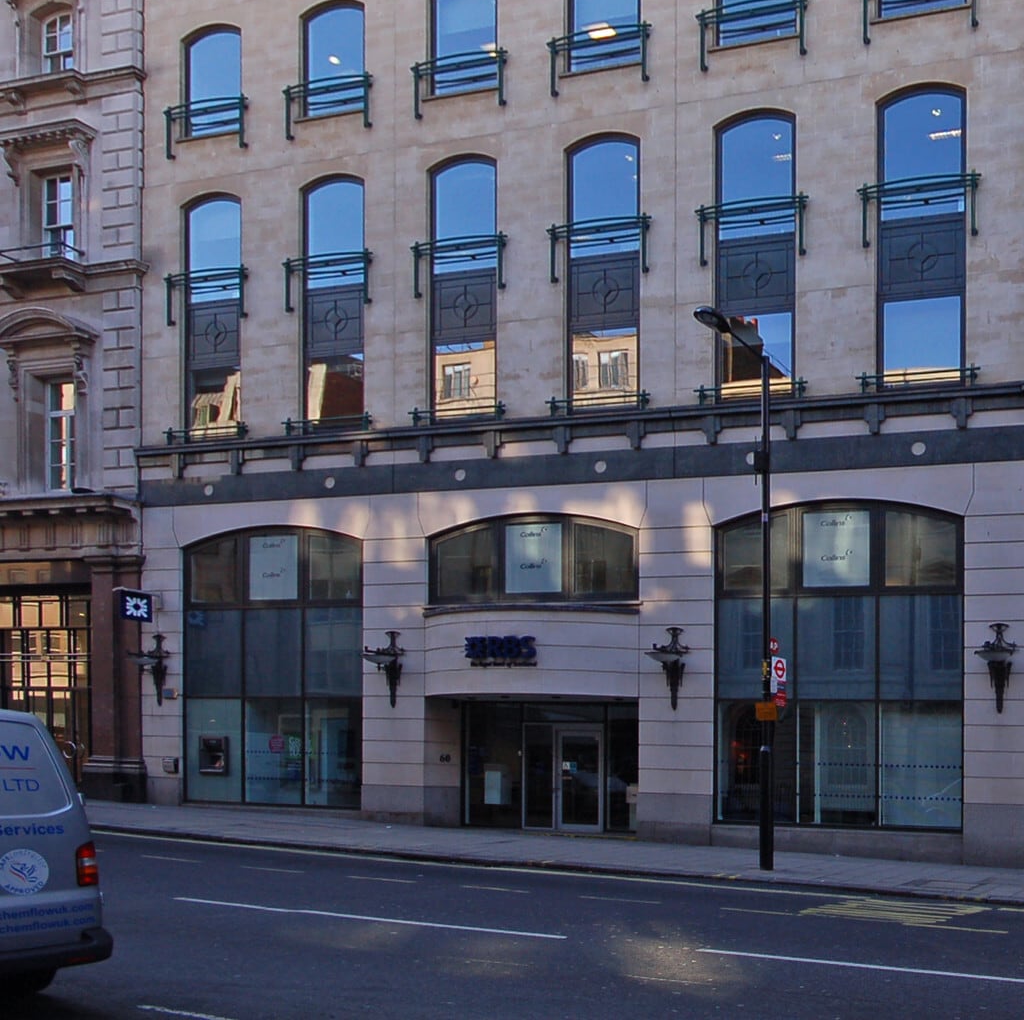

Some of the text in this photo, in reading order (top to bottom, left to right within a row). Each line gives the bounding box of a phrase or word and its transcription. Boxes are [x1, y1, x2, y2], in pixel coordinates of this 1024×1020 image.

[487, 635, 537, 658] RBS
[439, 754, 451, 763] 60
[3, 779, 40, 792] LTD
[4, 881, 44, 894] APPROVED
